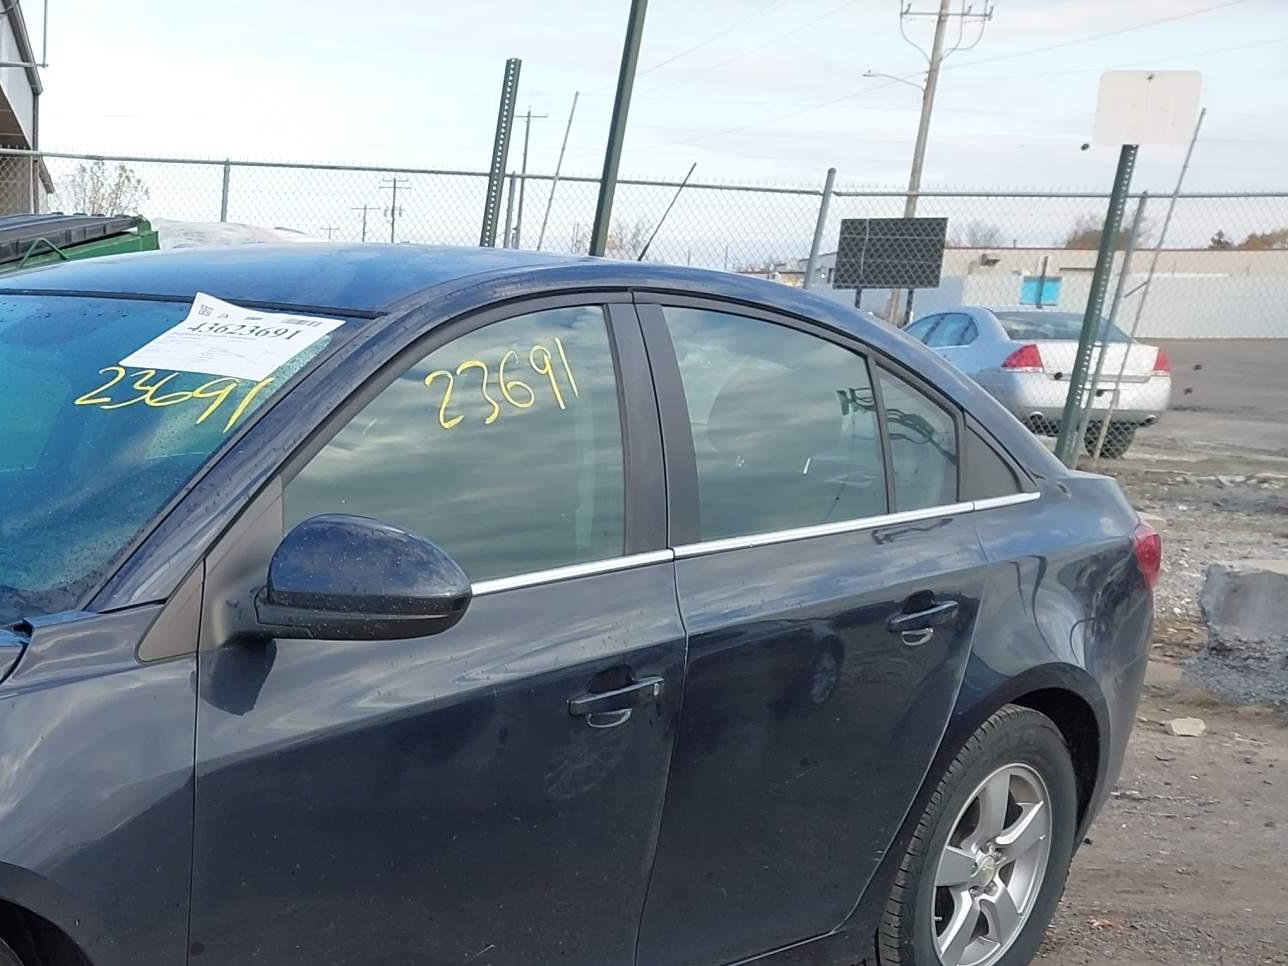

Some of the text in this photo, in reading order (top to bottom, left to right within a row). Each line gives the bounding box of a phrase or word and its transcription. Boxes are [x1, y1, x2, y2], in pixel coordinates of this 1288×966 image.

[187, 321, 303, 340] 43623691
[74, 366, 275, 433] 23691
[424, 337, 579, 429] 23691
